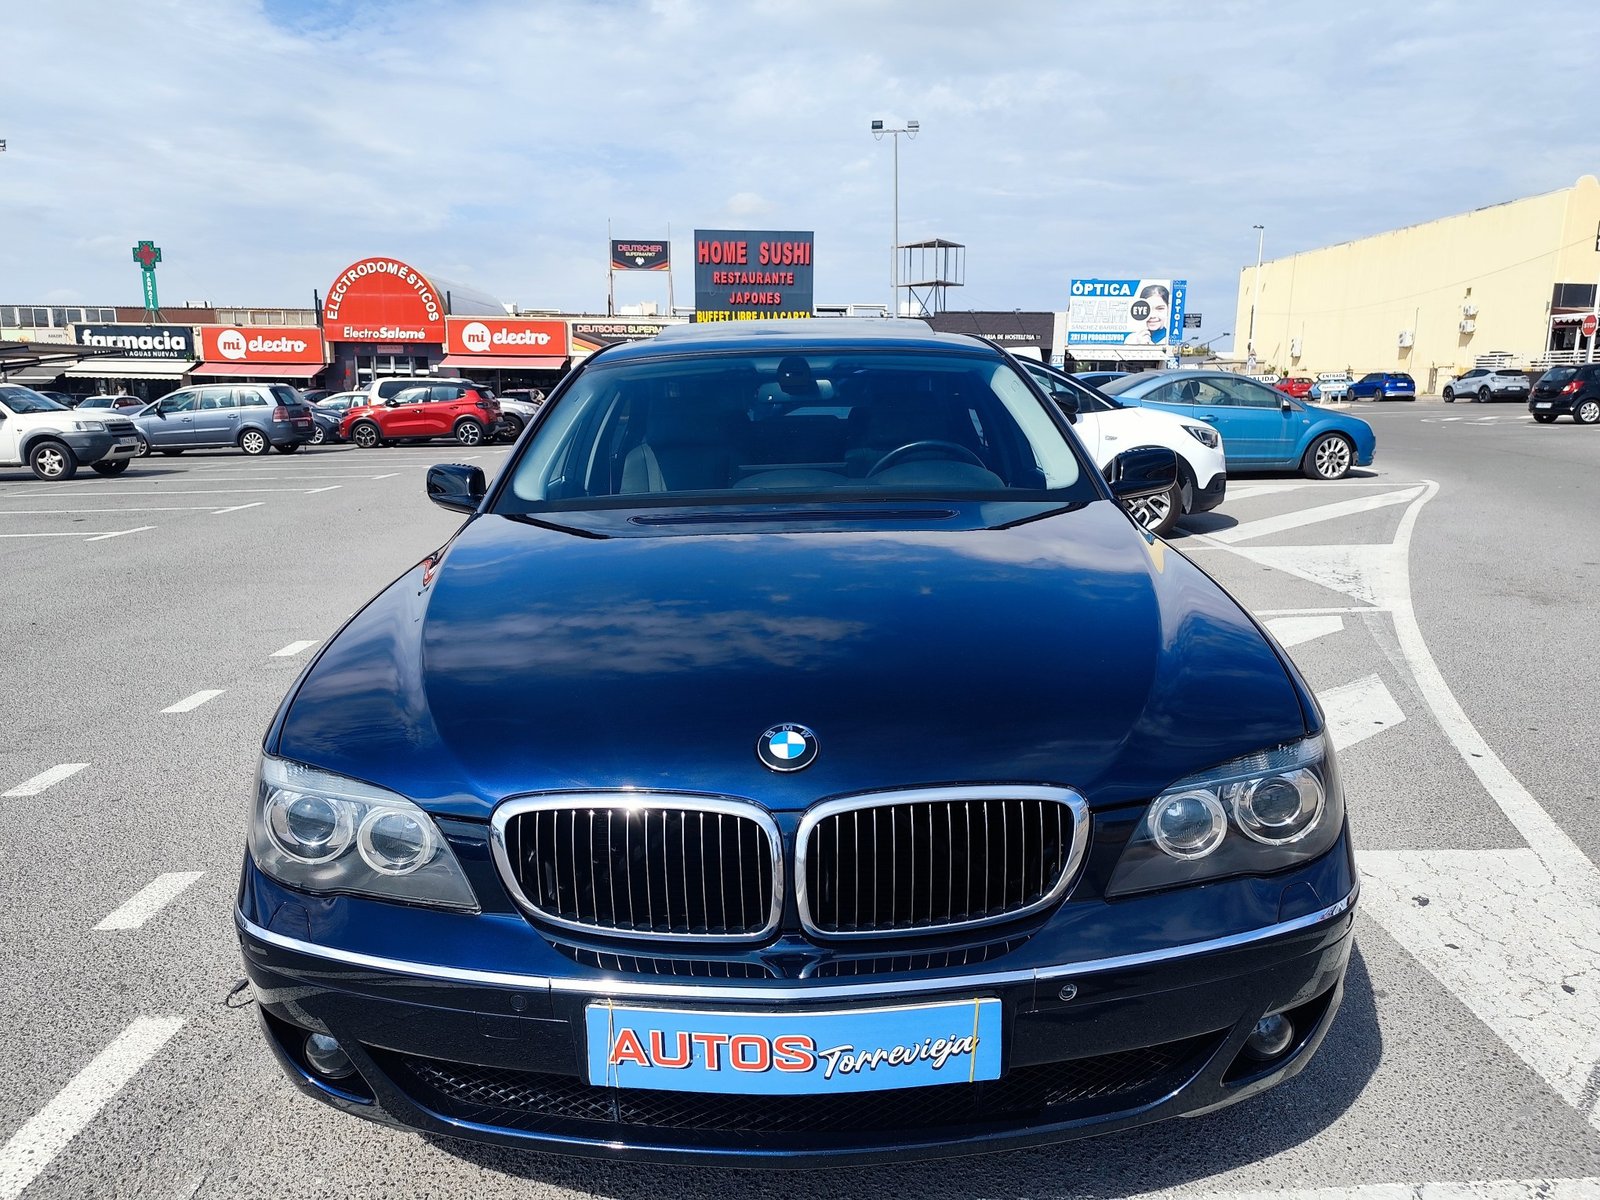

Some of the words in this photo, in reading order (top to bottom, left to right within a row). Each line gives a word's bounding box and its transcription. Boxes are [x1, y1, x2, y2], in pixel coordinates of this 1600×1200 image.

[617, 244, 663, 252] DEUTSCHER
[698, 240, 748, 264] HOME
[759, 241, 811, 266] SUSHI
[713, 271, 794, 285] RESTAURANTE
[146, 272, 155, 309] FARMACIA
[327, 261, 440, 322] ELECTRODOMÉSTICOS
[1072, 281, 1131, 296] ÓPTICA
[729, 291, 781, 305] JAPONES
[696, 310, 730, 323] BUFFET
[1132, 306, 1148, 316] EYE
[343, 326, 426, 340] ElectroSalomé
[468, 331, 485, 343] mi
[492, 328, 551, 345] electro
[577, 325, 627, 333] DEUTSCHER
[627, 326, 664, 334] SUPERM
[82, 329, 186, 350] farmacia
[223, 338, 241, 350] mi
[248, 335, 307, 353] electro
[764, 725, 812, 738] BMW
[609, 1027, 818, 1073] AUTOS
[818, 1034, 980, 1080] Torrevieja
